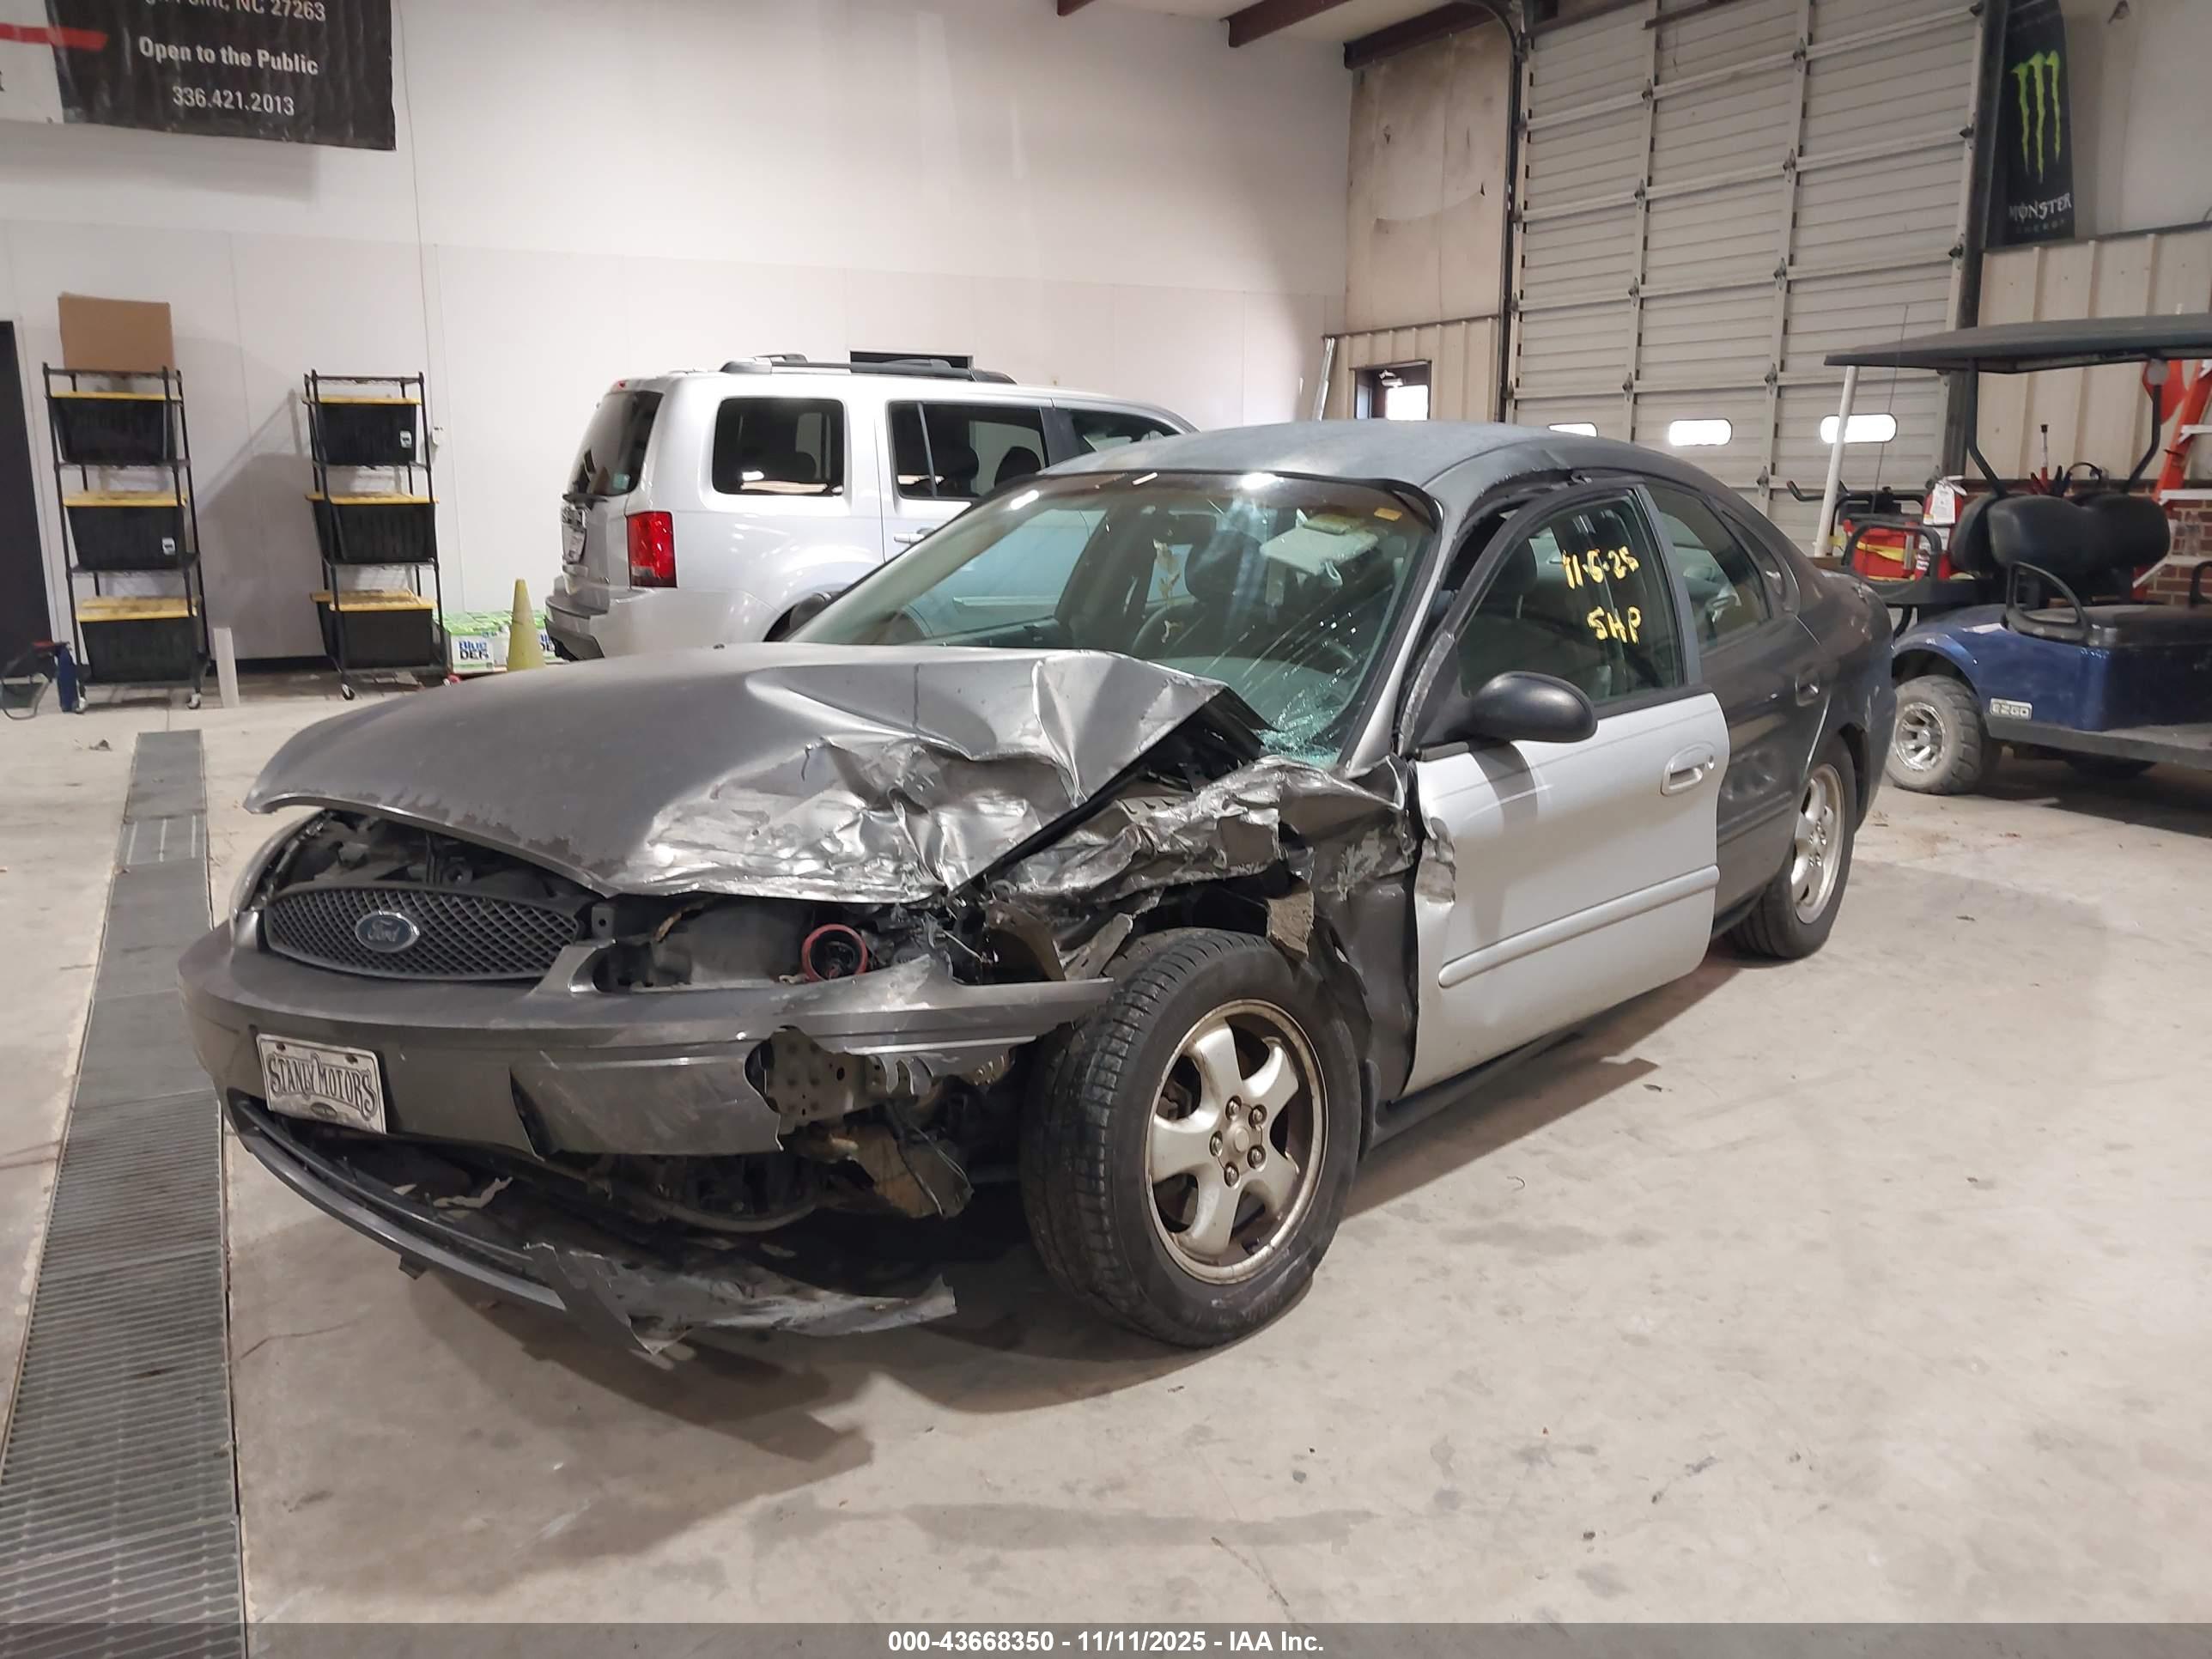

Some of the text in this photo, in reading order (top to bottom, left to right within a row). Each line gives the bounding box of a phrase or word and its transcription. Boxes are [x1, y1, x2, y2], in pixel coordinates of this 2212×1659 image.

[270, 0, 326, 21] 27263
[138, 36, 319, 75] Open to the Public
[173, 86, 295, 116] 336.421.2013
[2009, 192, 2072, 222] MONSTER
[266, 1047, 378, 1122] STANLY MOTORS
